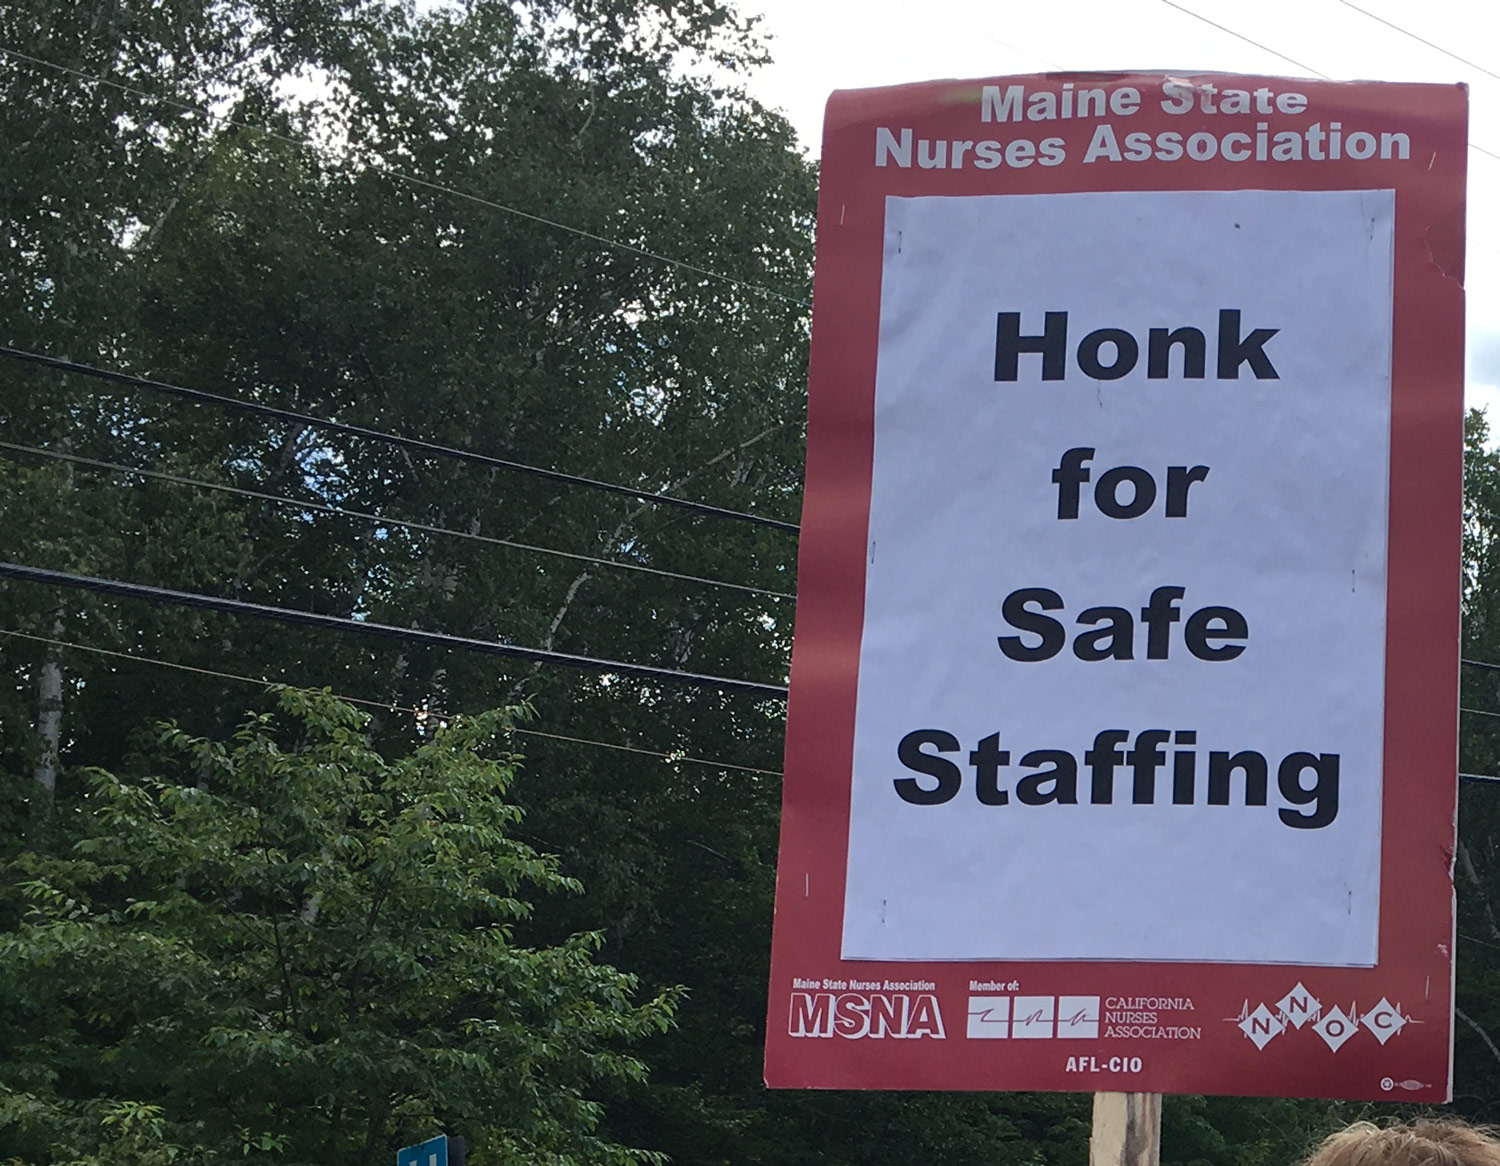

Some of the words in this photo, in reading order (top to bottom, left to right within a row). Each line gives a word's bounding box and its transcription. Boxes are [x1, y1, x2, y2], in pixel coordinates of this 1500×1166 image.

[980, 84, 1141, 123] Maine
[1160, 80, 1309, 117] State
[875, 127, 1066, 170] Nurses
[1083, 121, 1411, 164] Association
[993, 308, 1281, 382] Honk
[1051, 446, 1211, 520] for
[997, 585, 1249, 663] Safe
[892, 728, 1341, 830] Staffing
[793, 978, 820, 990] Maine
[822, 978, 847, 990] State
[849, 979, 881, 991] Nurses
[882, 979, 936, 991] Association
[969, 980, 1005, 992] Member
[1007, 980, 1020, 992] of:
[1105, 996, 1195, 1011] CALIFORNIA
[788, 992, 946, 1040] MSNA
[1104, 1011, 1158, 1025] NURSES
[1104, 1025, 1202, 1040] ASSOCIATION
[1065, 1056, 1143, 1073] AFL-CIO
